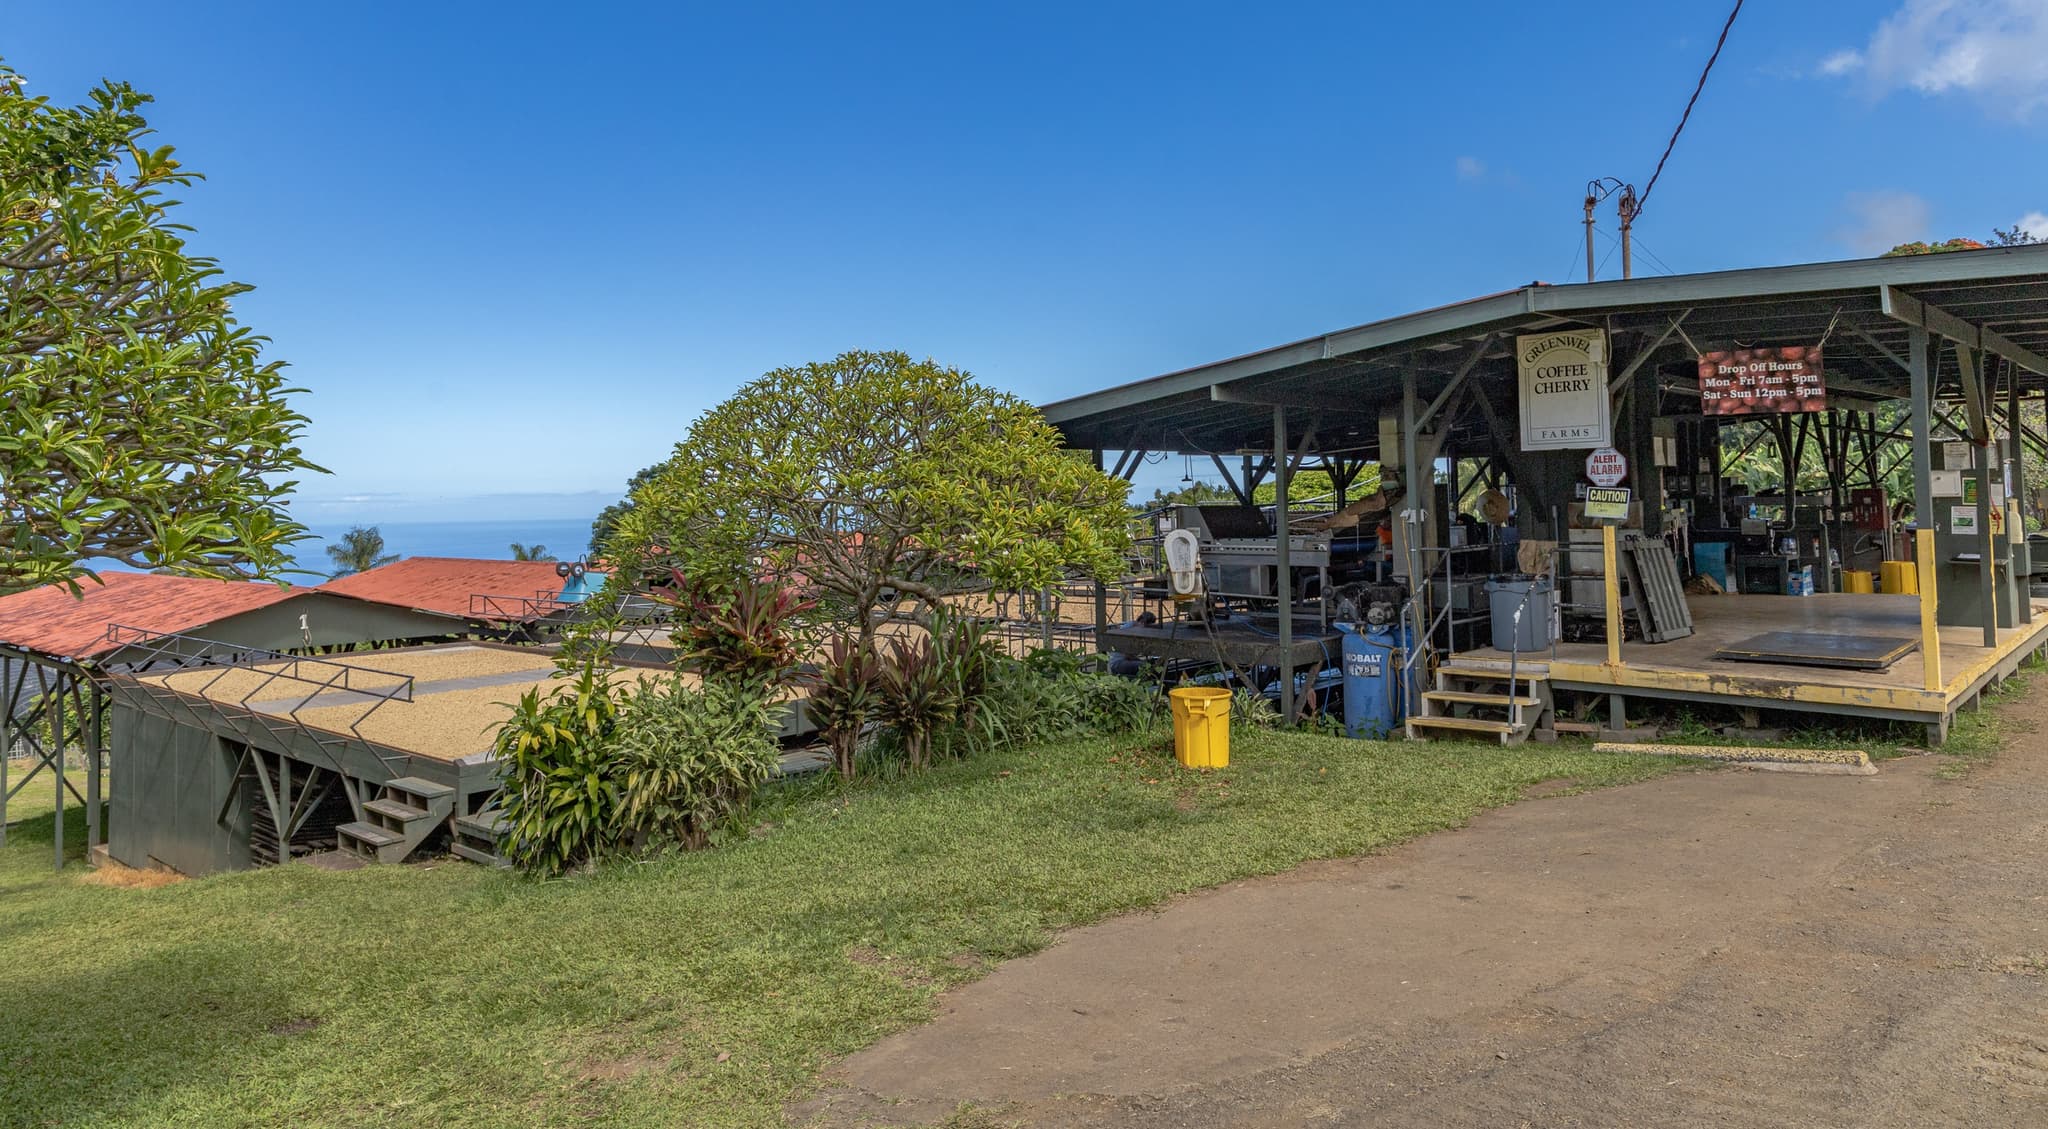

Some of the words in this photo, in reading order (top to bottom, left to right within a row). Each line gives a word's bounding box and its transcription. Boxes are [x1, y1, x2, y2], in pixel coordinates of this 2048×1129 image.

[1525, 336, 1591, 363] GREENWEL
[1537, 364, 1589, 379] COFFEE
[1718, 365, 1747, 375] Drop
[1750, 362, 1766, 372] Off
[1768, 362, 1803, 371] Hours
[1534, 379, 1591, 394] CHERRY
[1705, 378, 1730, 387] Mon
[1740, 376, 1756, 385] Fri
[1758, 375, 1783, 384] 7am
[1792, 374, 1818, 384] 5pm
[1703, 390, 1721, 400] Sat
[1730, 390, 1752, 398] Sun
[1755, 388, 1787, 399] 12pm
[1796, 386, 1822, 398] 5pm
[1542, 429, 1589, 439] FARMS
[1593, 455, 1617, 464] ALERT
[1590, 464, 1623, 475] ALARM
[1590, 490, 1627, 502] CAUTION
